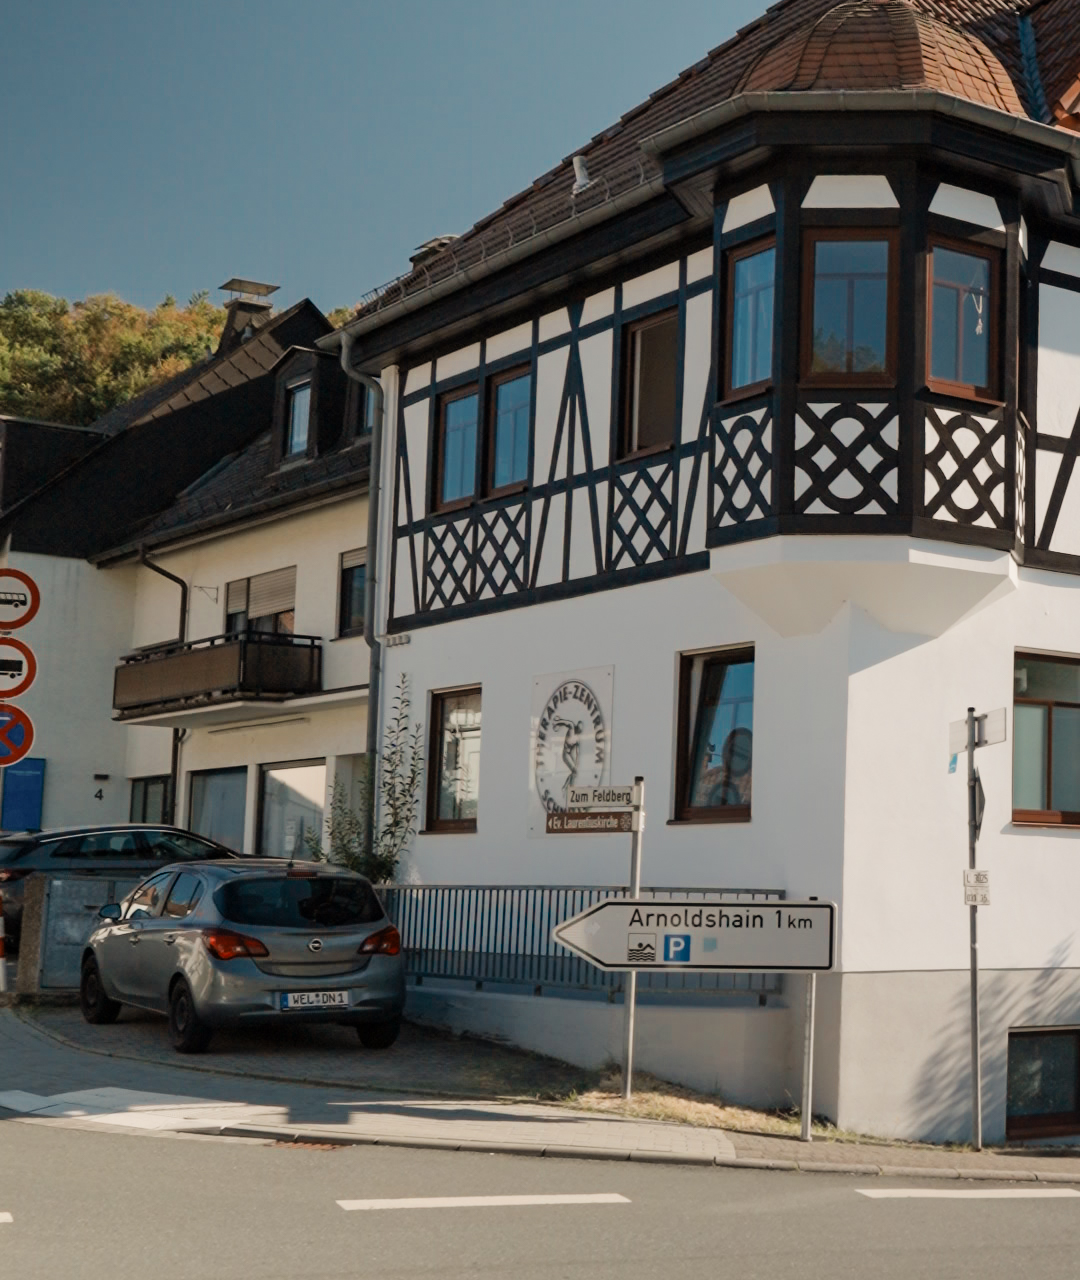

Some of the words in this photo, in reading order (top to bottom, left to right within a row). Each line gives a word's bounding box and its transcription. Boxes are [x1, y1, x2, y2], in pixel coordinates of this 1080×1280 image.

[536, 684, 605, 769] THERAPIE-ZENTRUM
[94, 788, 104, 801] 4
[570, 790, 589, 803] Zum
[592, 789, 632, 805] Feldberg
[552, 816, 563, 829] Ev.
[563, 816, 618, 829] Laurentiuskirche
[629, 908, 764, 929] Arnoldshain
[775, 910, 783, 929] 1
[788, 914, 813, 929] km
[669, 937, 685, 960] P
[292, 993, 314, 1005] WEL
[321, 992, 336, 1004] DN
